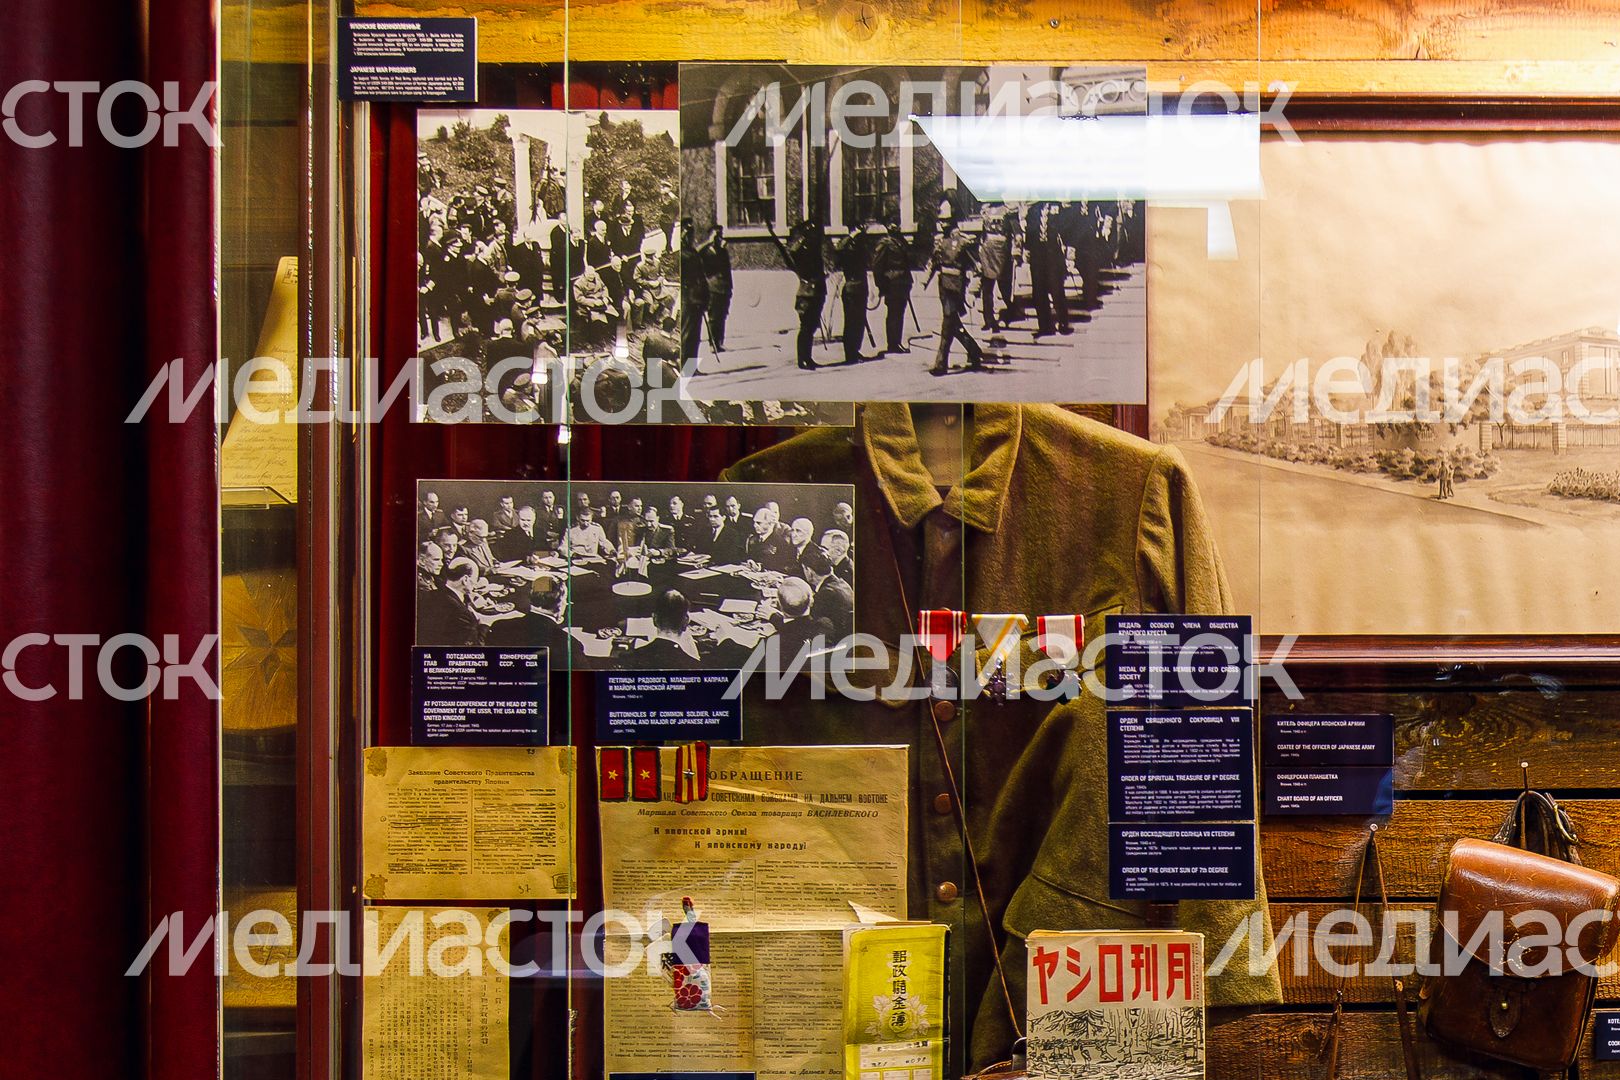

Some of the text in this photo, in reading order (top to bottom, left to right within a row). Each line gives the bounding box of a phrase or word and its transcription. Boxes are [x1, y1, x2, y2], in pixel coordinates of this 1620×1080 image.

[709, 771, 803, 781] ОБРАЩЕНИЕ
[804, 794, 814, 803] НА
[820, 794, 852, 804] ДАЛЬНЕМ
[637, 808, 878, 818] Маршала Советского Союза товарища ВАСИЛЕВСКОГО
[665, 827, 711, 835] японской
[695, 841, 807, 851] К японскому народу!
